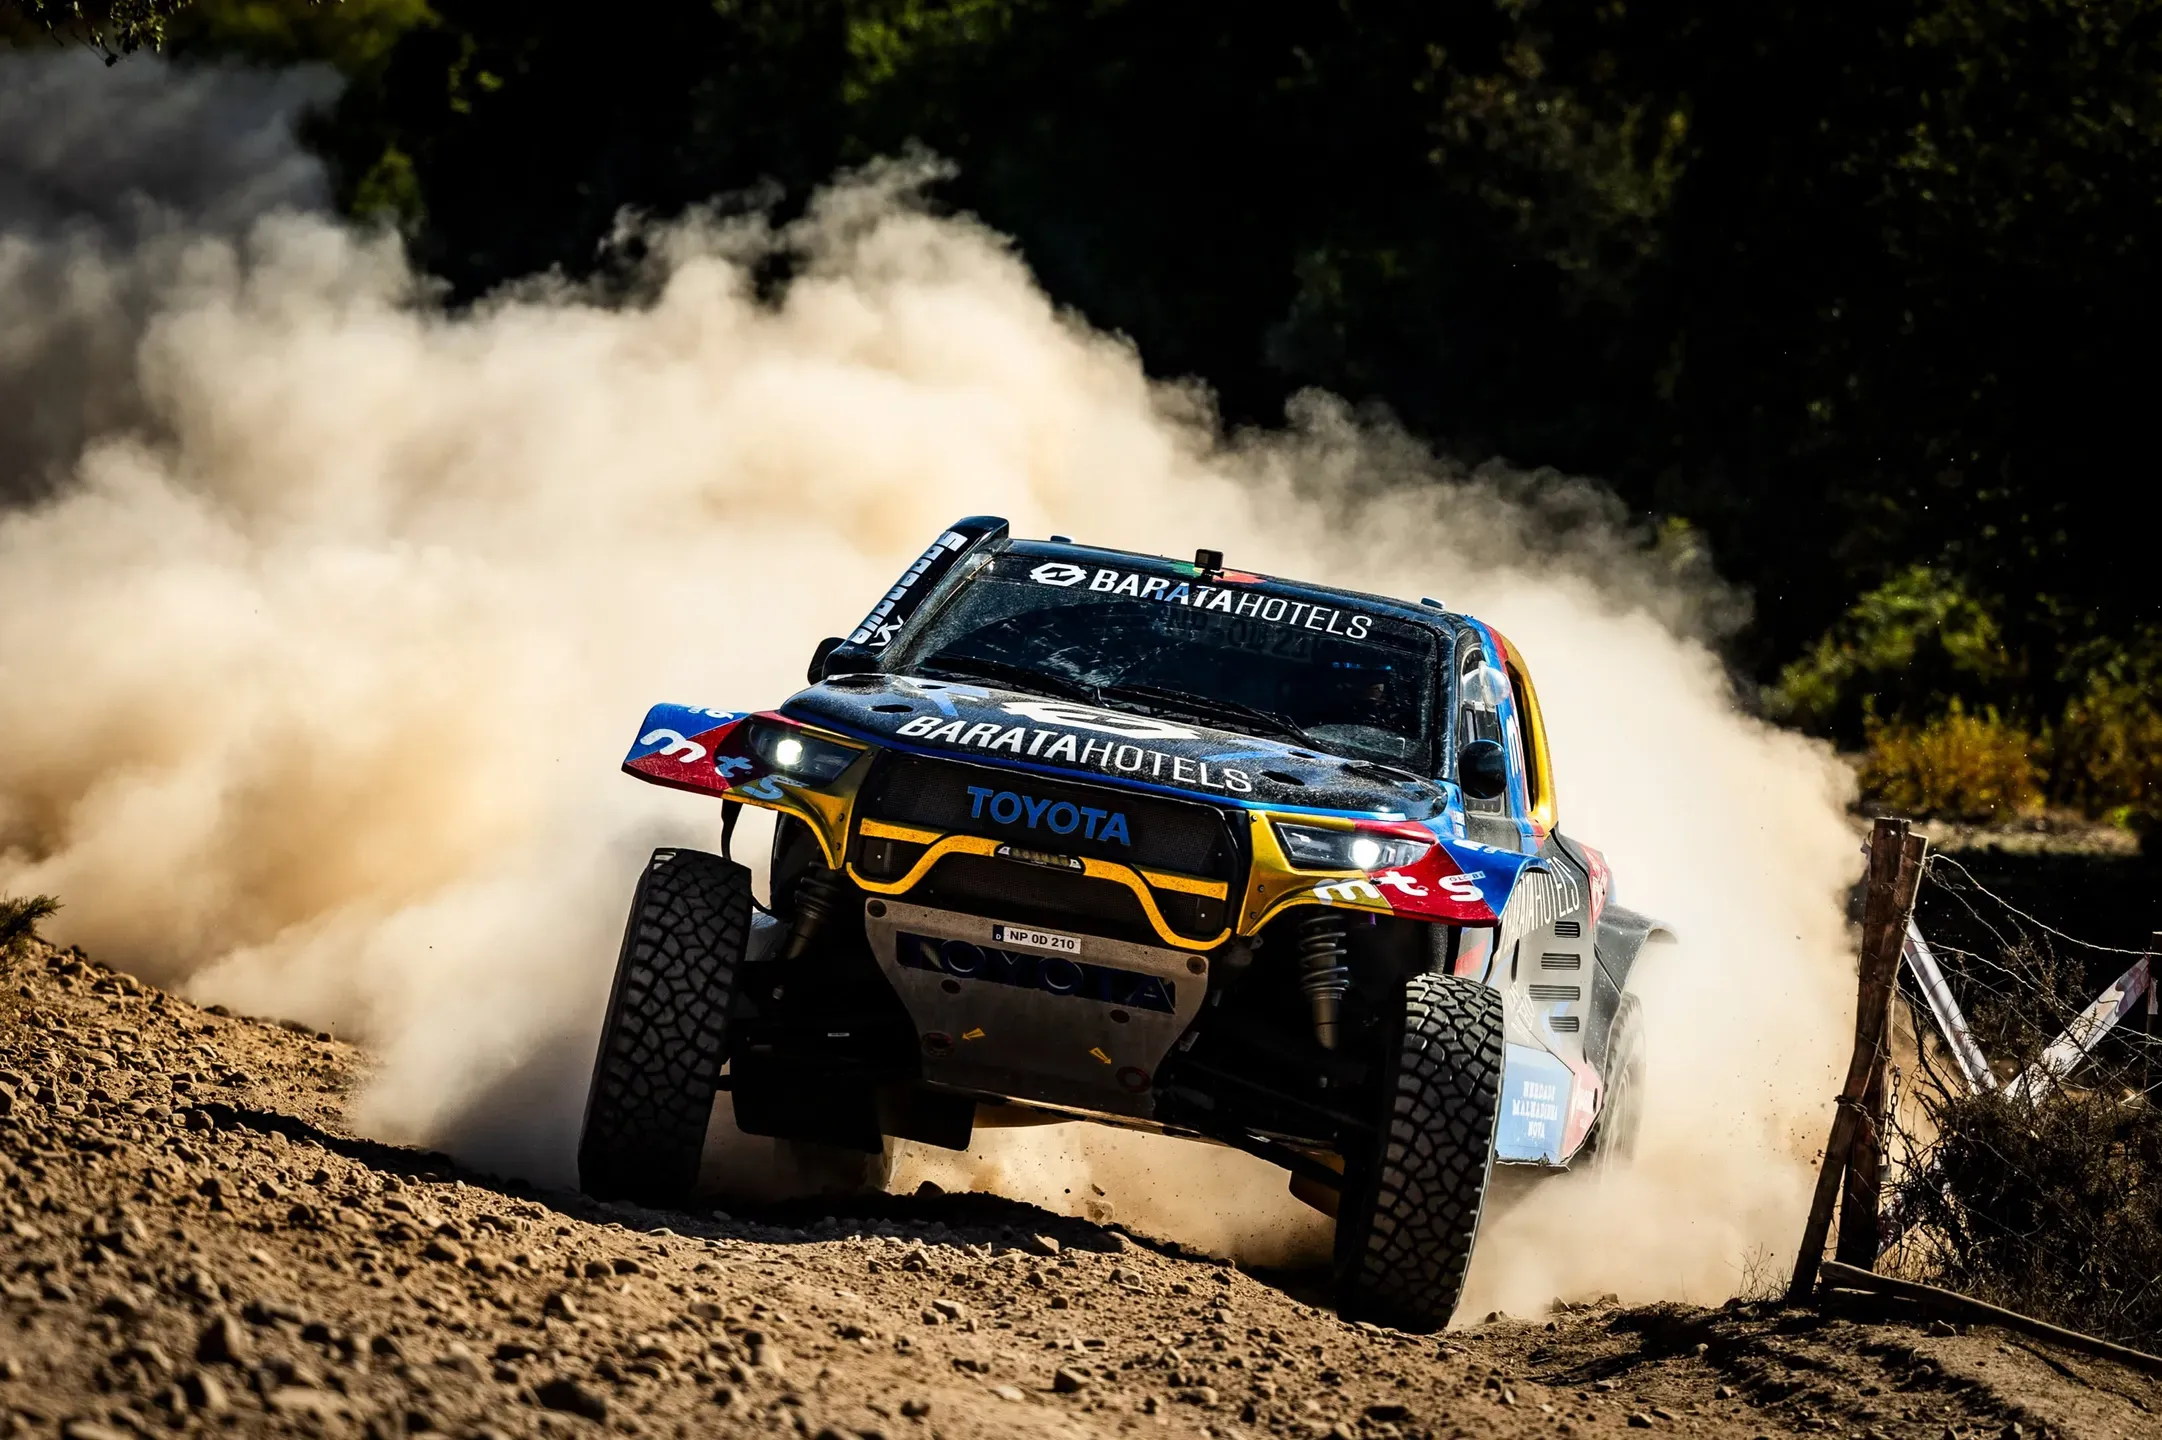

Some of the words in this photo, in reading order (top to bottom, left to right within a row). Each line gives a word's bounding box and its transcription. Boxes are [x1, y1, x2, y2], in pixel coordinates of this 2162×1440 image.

[968, 786, 1131, 846] TOYOTA
[1009, 931, 1028, 941] NP
[1051, 937, 1075, 950] 210
